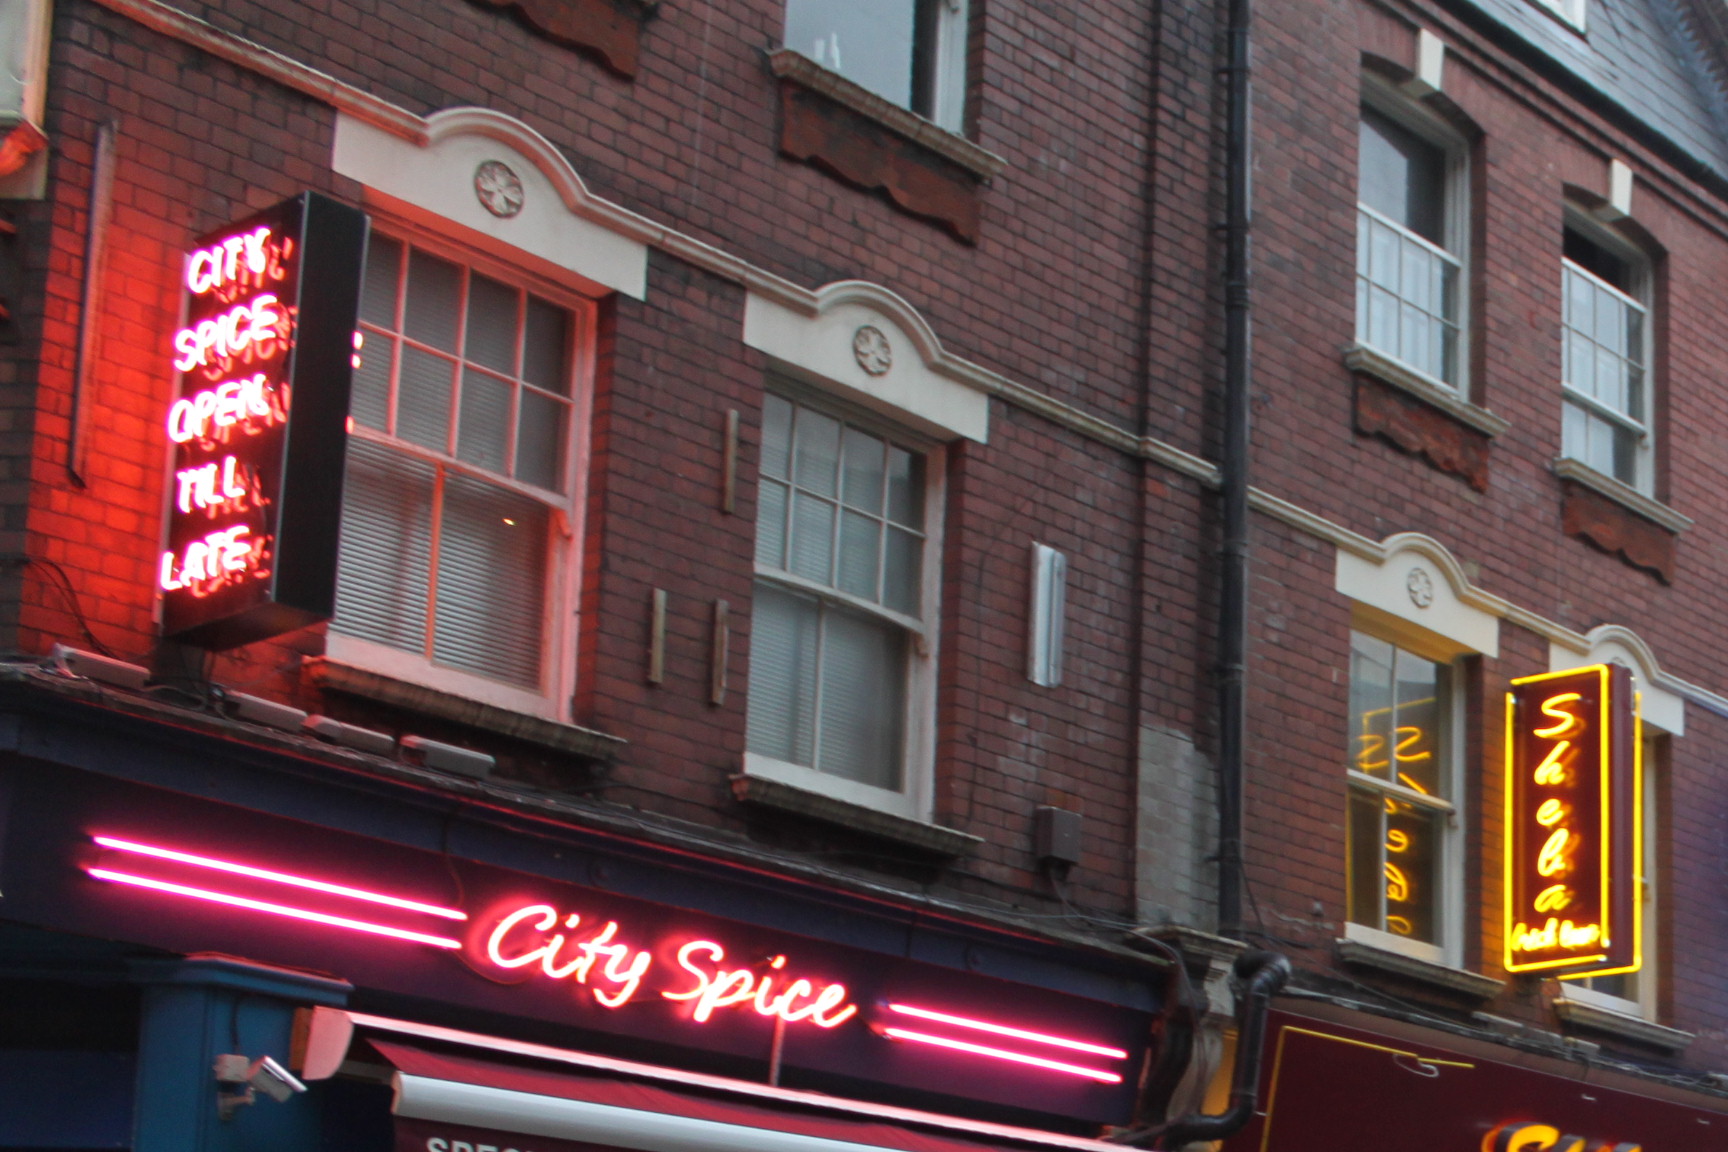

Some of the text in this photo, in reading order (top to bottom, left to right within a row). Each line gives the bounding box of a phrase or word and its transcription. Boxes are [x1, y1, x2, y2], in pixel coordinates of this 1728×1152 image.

[189, 226, 272, 294] CITY
[174, 294, 279, 372] SPICE
[167, 375, 270, 443] OPEN
[176, 456, 246, 513] TILL
[160, 525, 252, 592] LATE
[1533, 692, 1581, 913] Sheba
[486, 903, 857, 1029] City Spice
